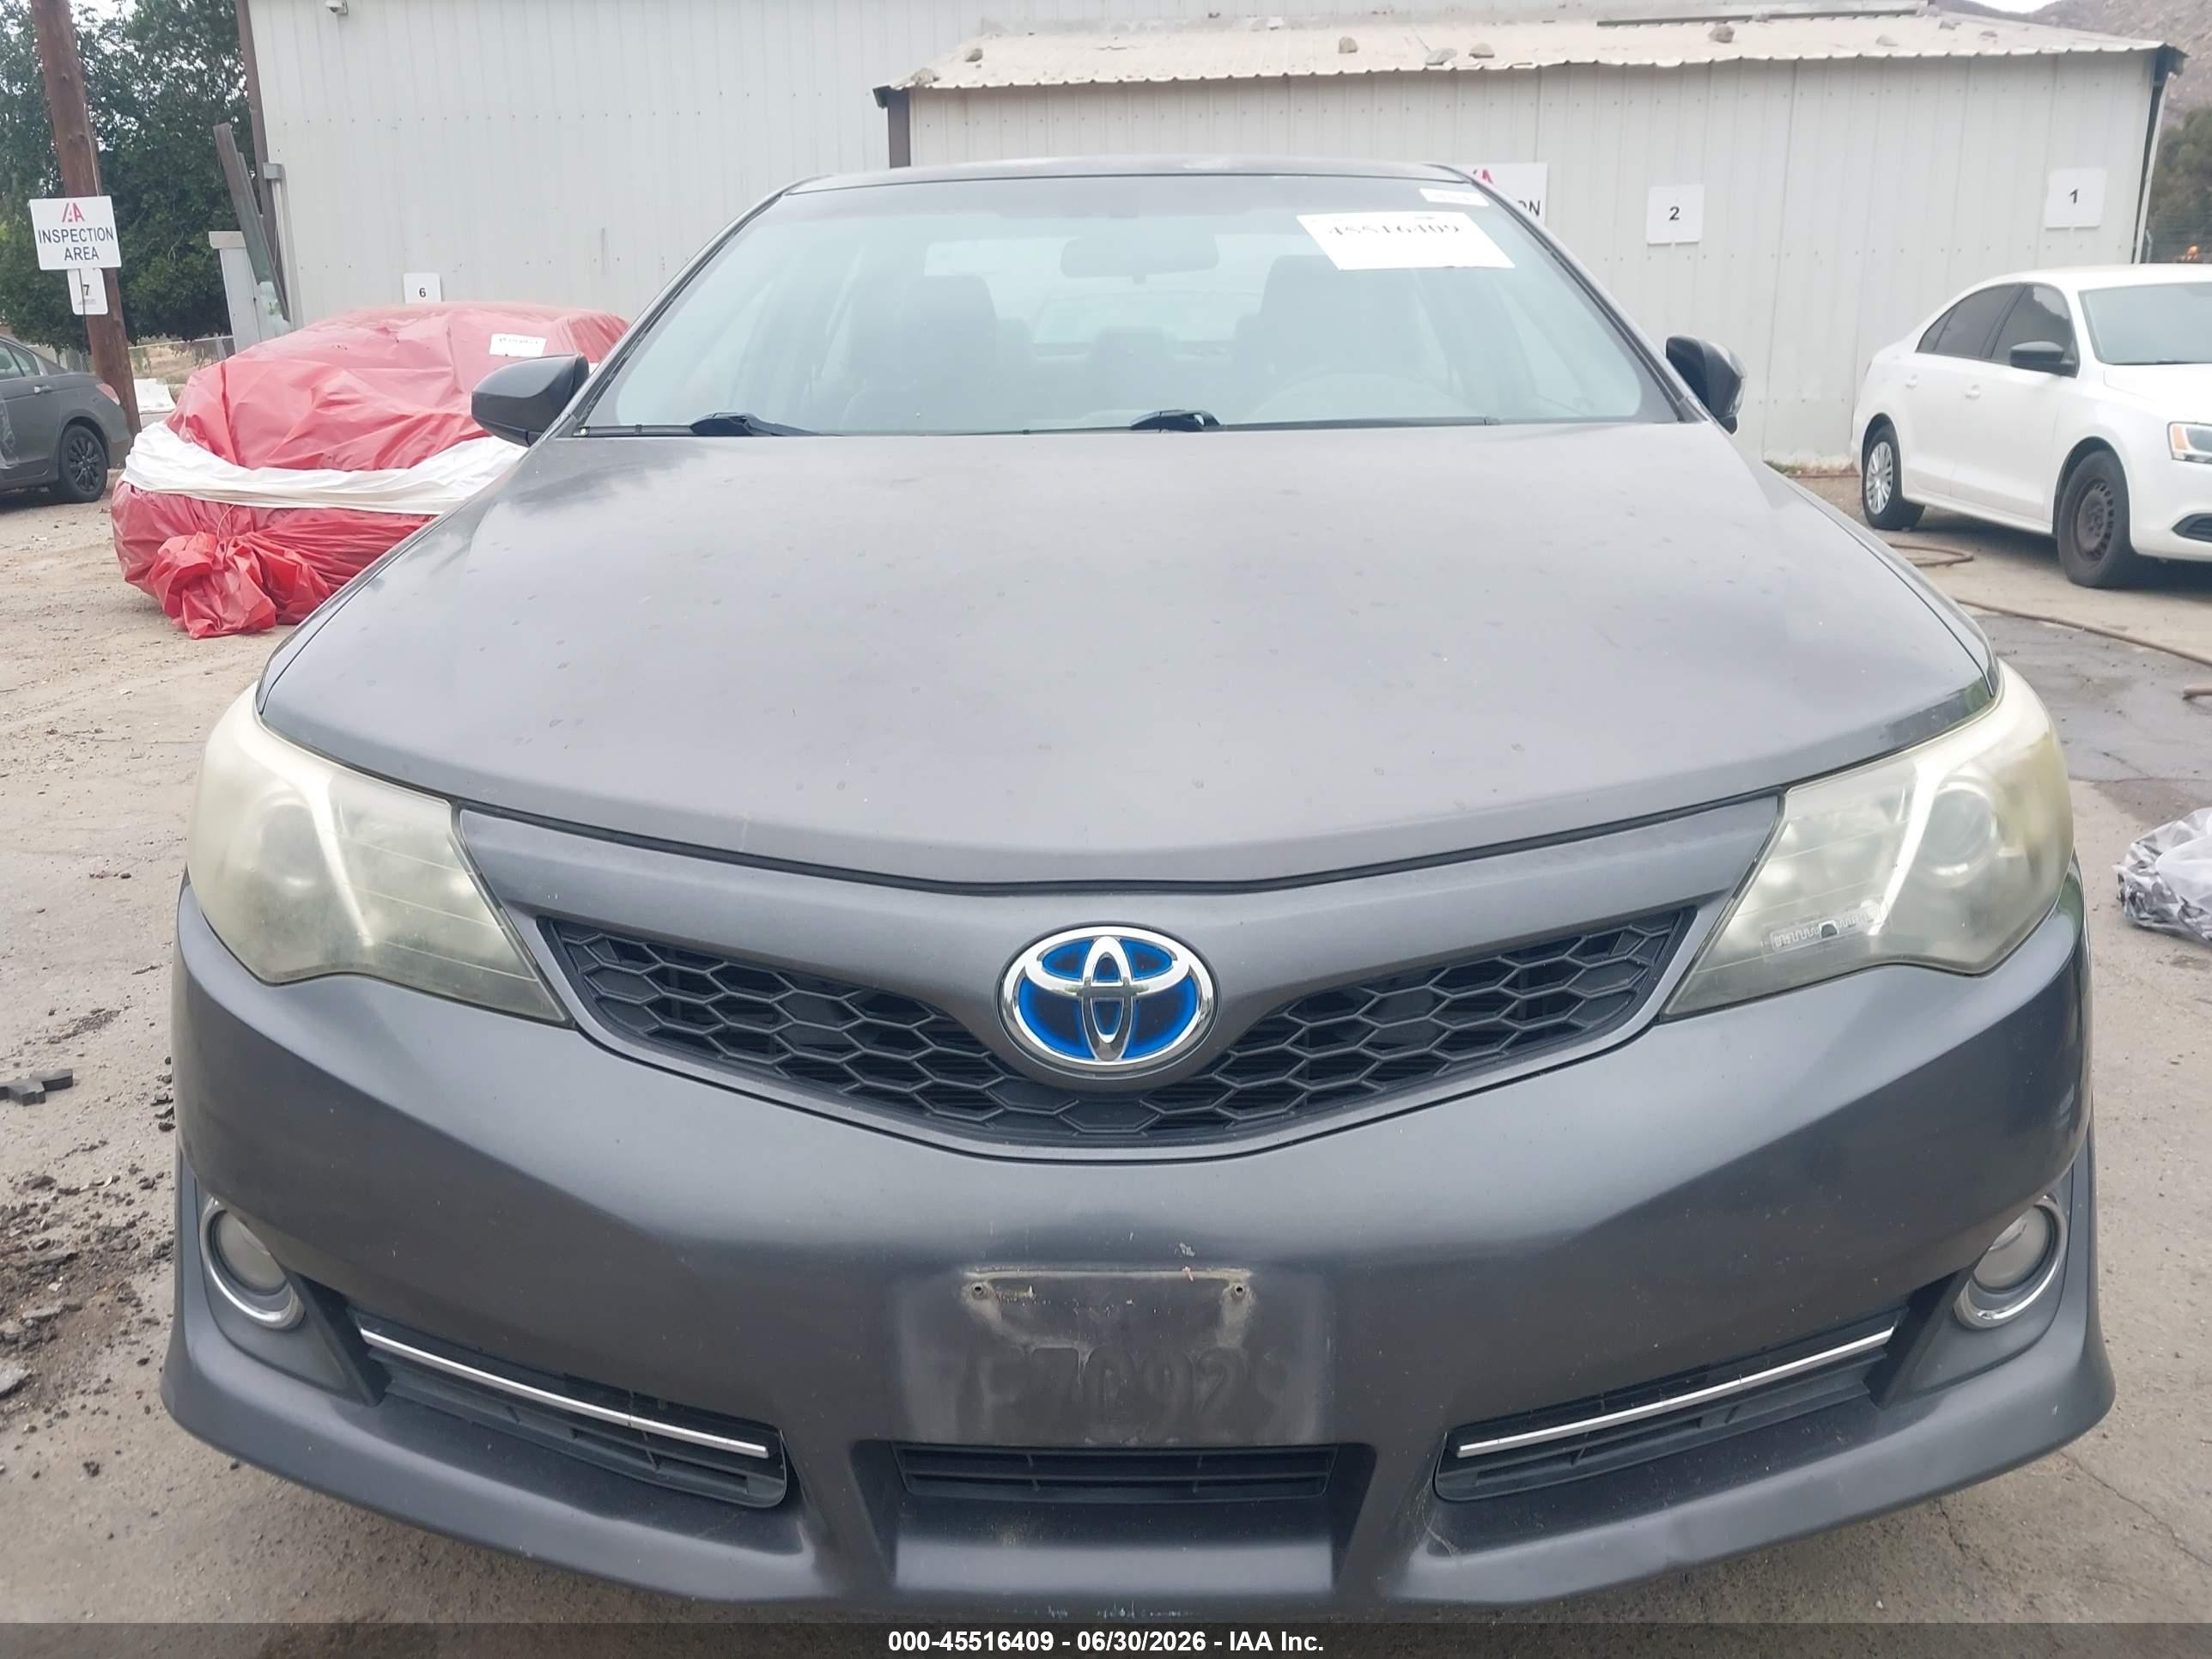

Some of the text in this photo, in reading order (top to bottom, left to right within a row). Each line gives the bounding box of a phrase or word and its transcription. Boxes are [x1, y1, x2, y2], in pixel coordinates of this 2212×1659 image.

[2069, 189, 2078, 204] 1
[1669, 206, 1680, 221] 2
[38, 227, 114, 244] INSPECTION
[64, 246, 100, 261] AREA
[82, 283, 90, 296] 7
[419, 287, 426, 298] 6
